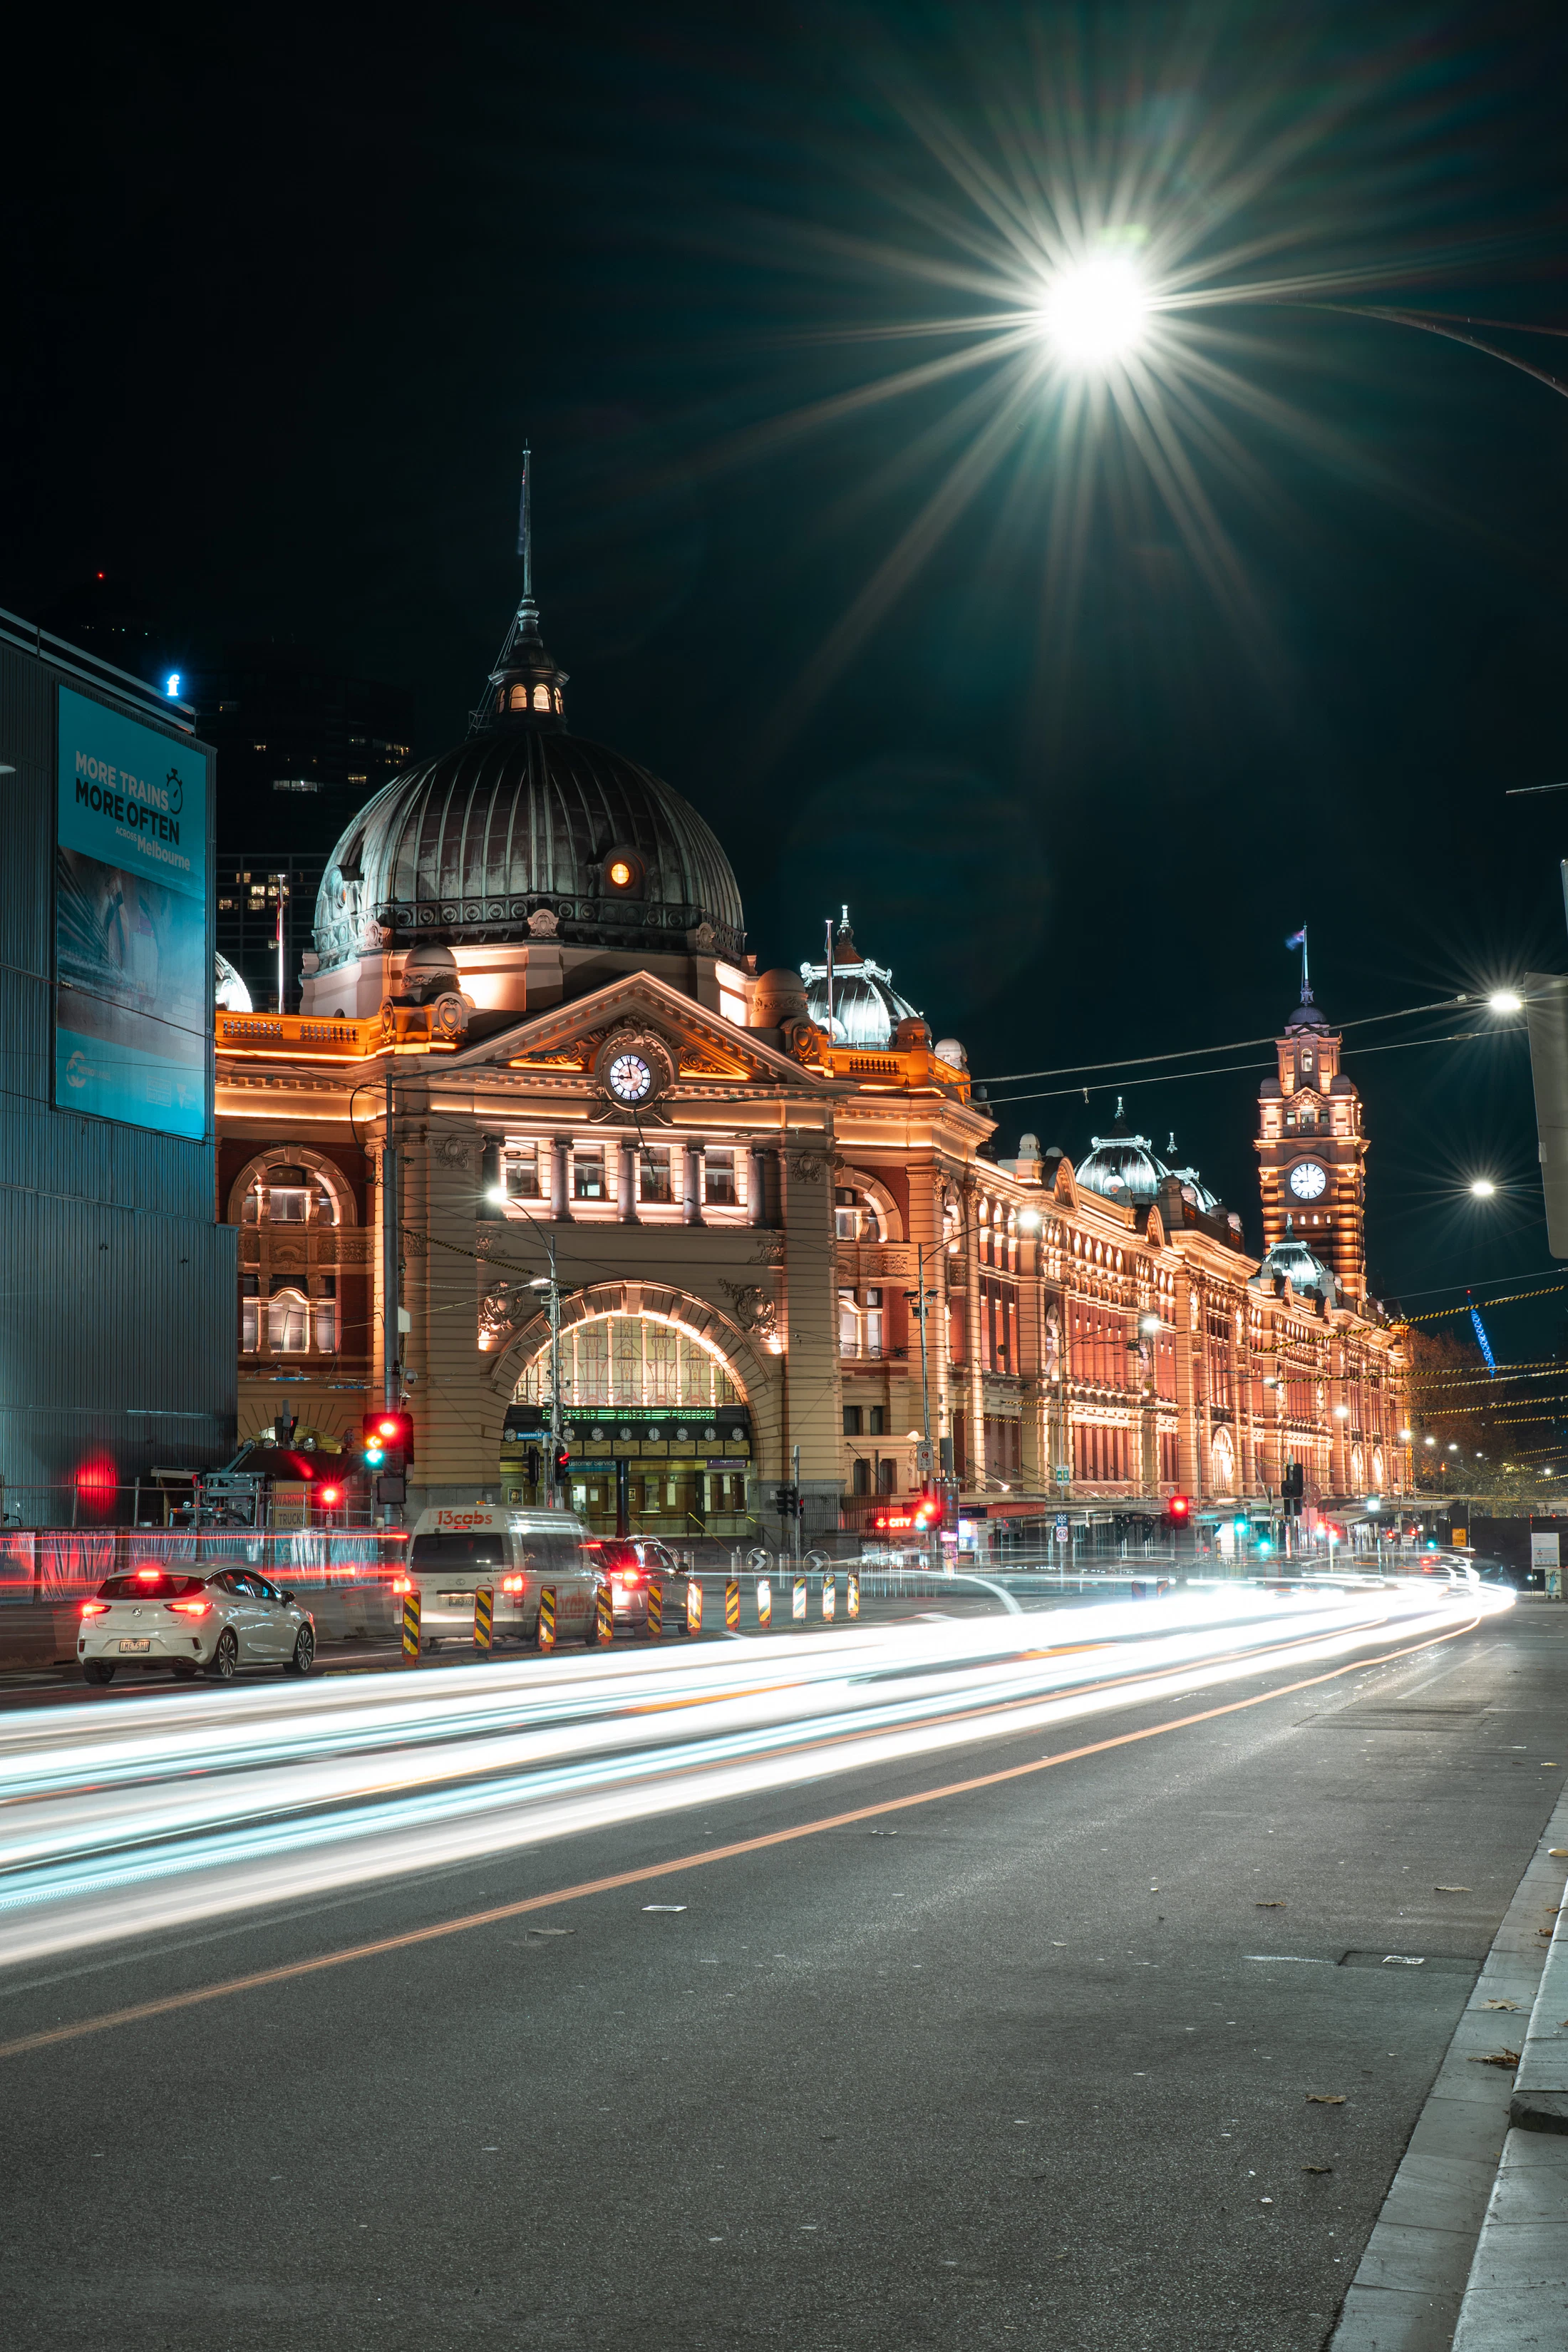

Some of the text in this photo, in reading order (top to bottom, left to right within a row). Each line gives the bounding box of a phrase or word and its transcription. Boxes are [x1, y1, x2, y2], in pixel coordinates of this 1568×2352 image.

[76, 751, 168, 811] MORE TRAINS
[76, 778, 180, 846] MORE OFTEN
[115, 826, 190, 871] ACROSS Melbourne
[438, 1510, 493, 1526] 13cabs
[889, 1517, 912, 1527] CITY
